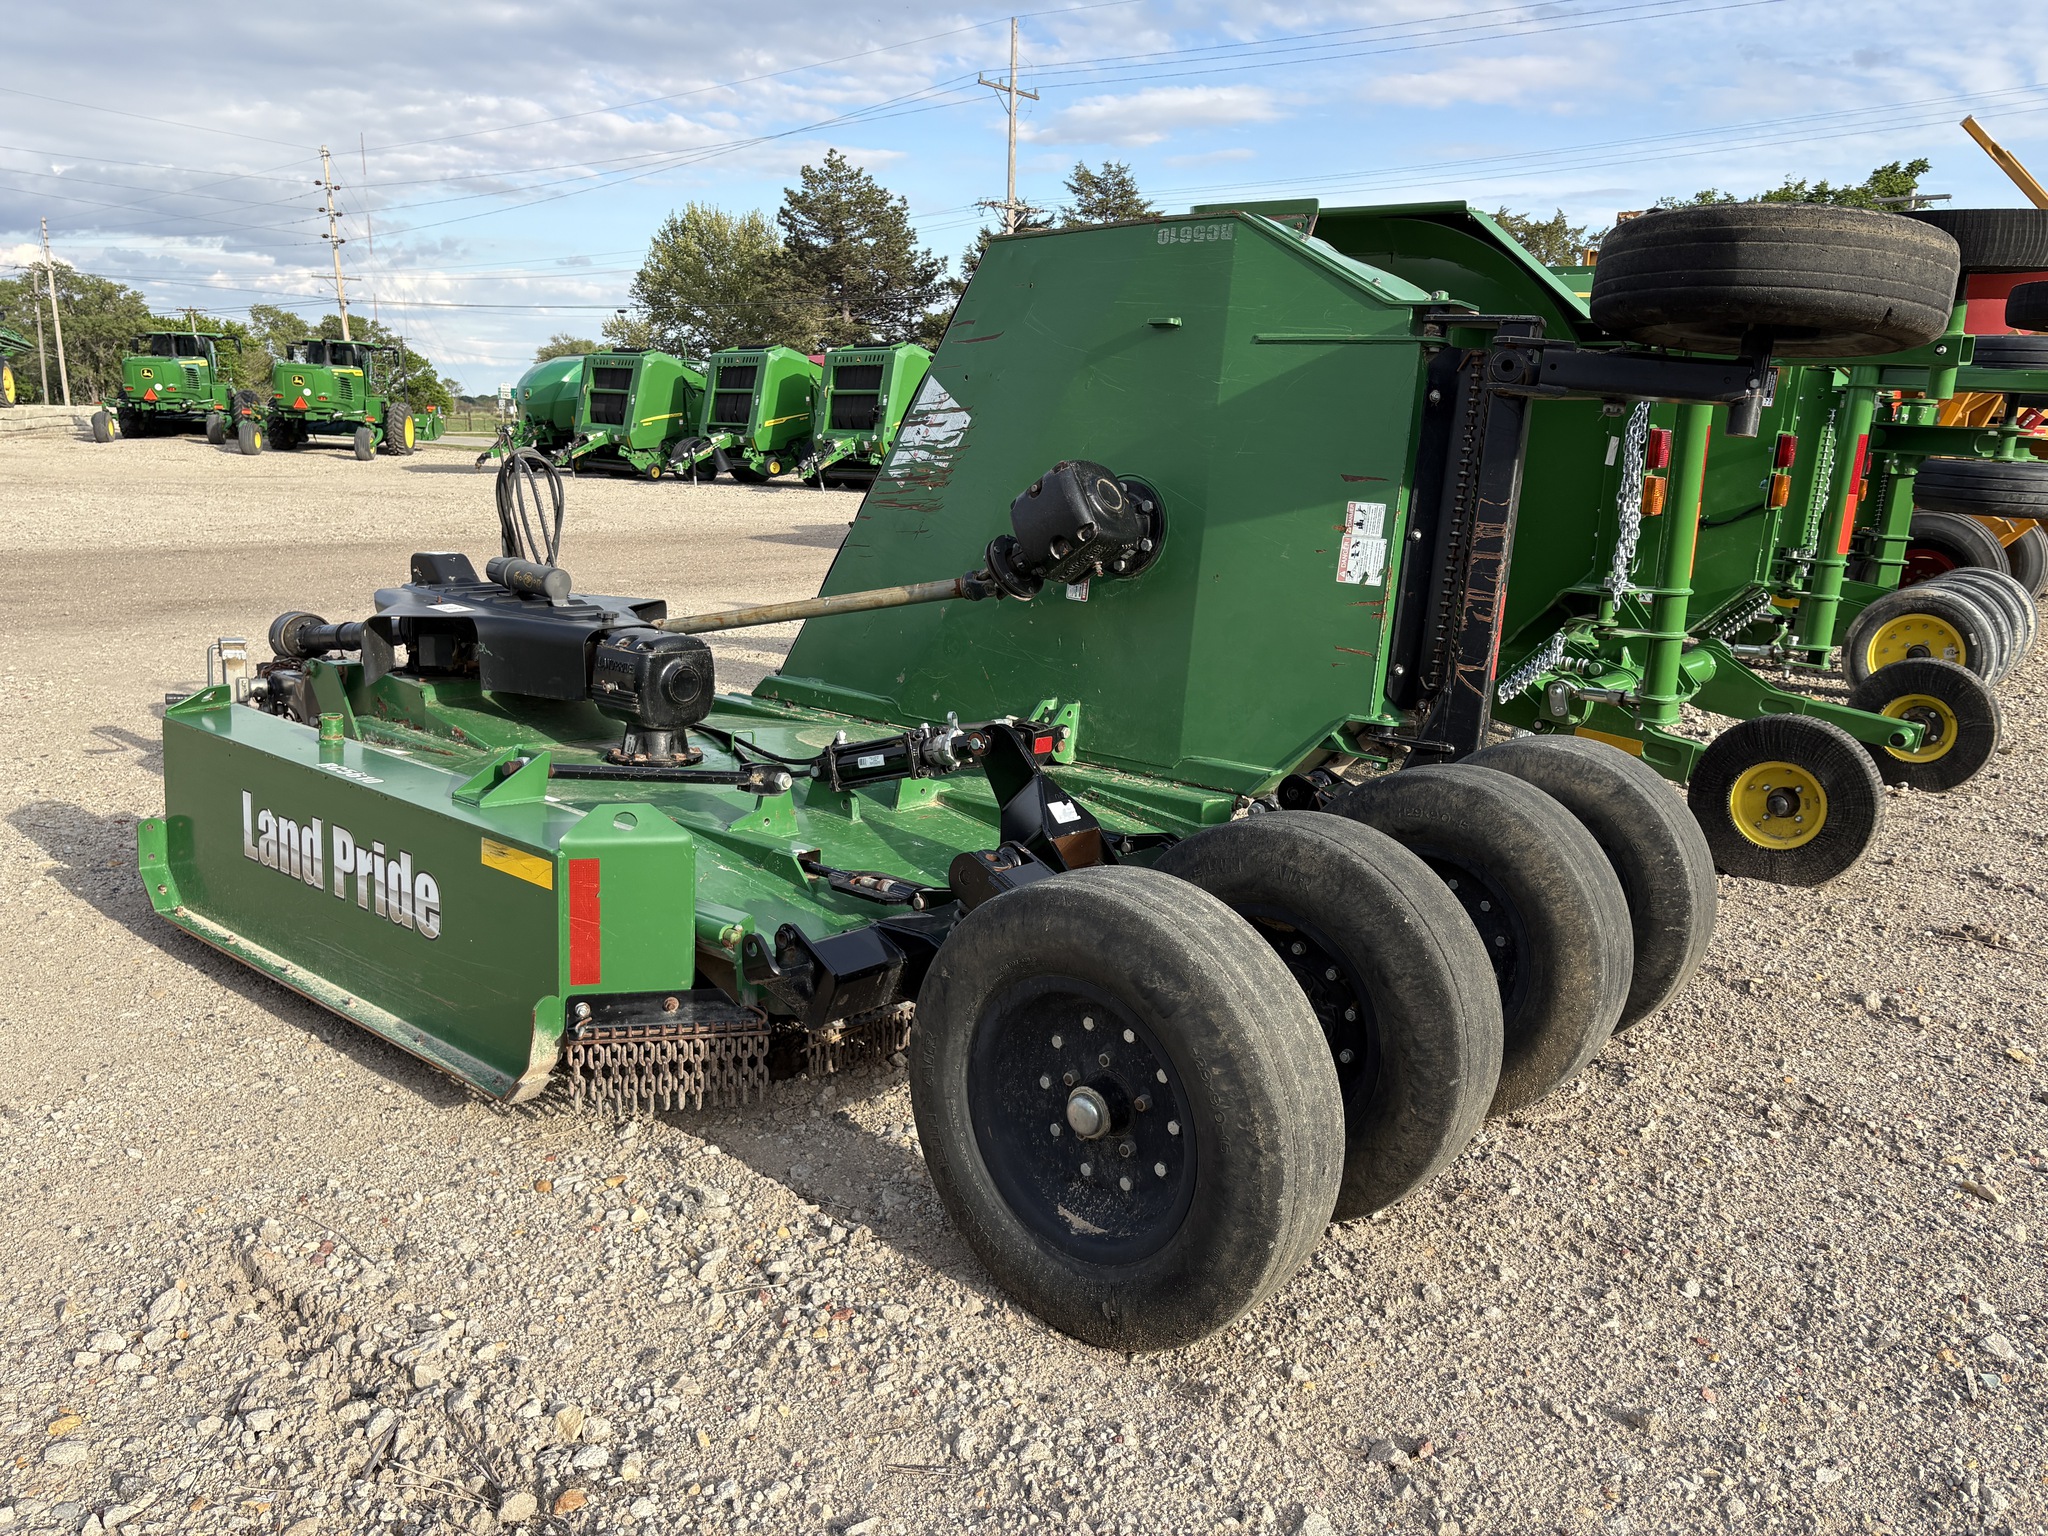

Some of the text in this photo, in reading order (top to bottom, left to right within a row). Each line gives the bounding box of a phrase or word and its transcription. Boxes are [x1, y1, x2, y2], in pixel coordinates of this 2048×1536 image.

[1157, 223, 1235, 245] RC5610
[1340, 541, 1350, 568] DANGER
[315, 762, 385, 784] RC5610
[241, 789, 442, 942] Land Pride
[923, 1030, 938, 1087] AIR
